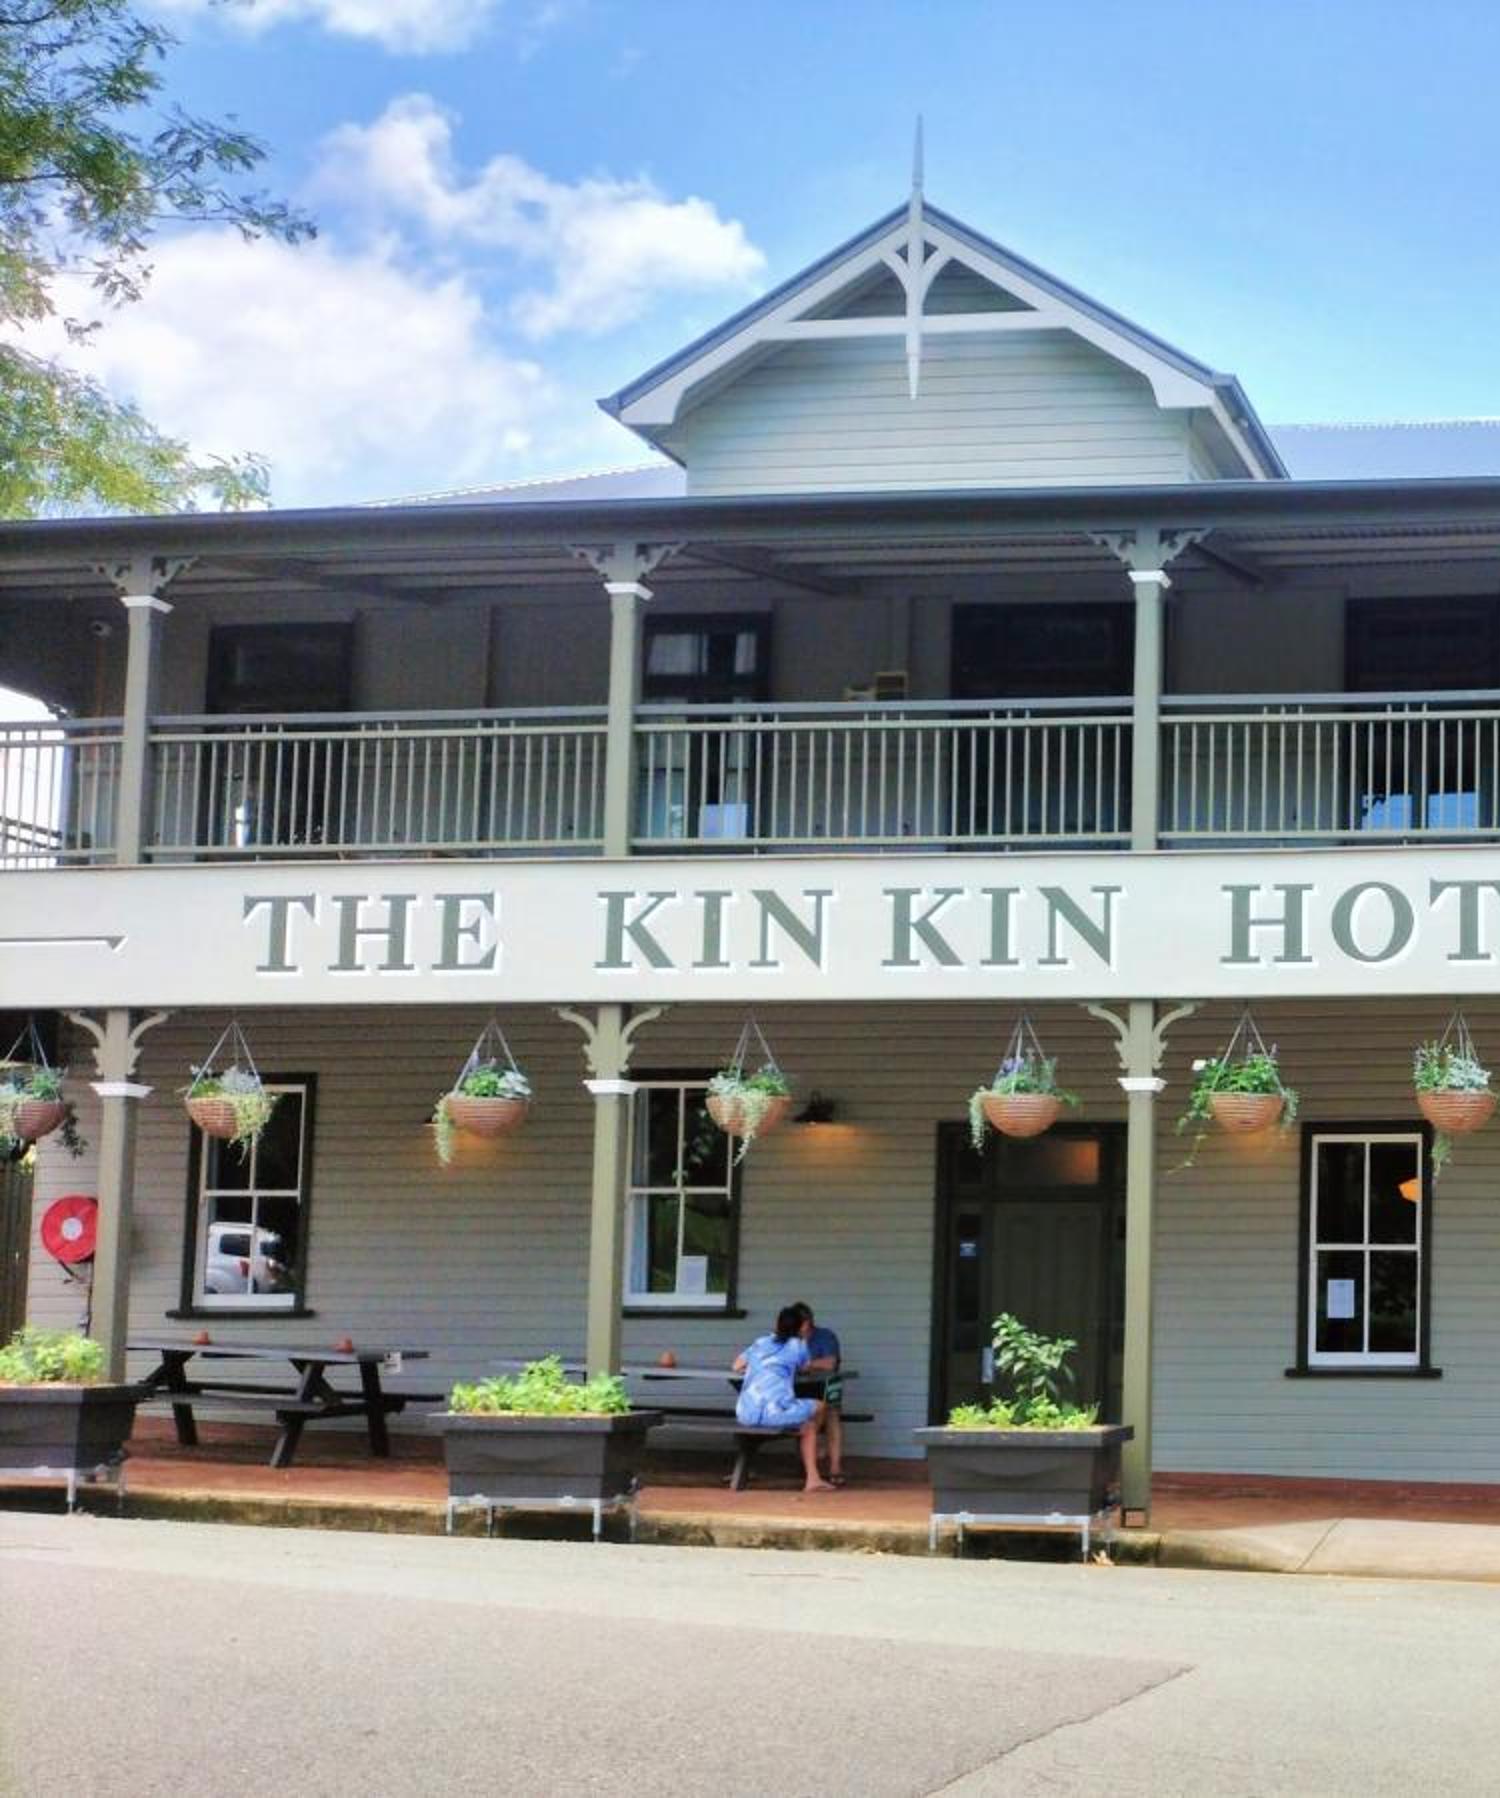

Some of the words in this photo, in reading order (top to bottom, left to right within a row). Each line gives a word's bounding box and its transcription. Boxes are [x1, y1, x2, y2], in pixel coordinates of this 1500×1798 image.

[243, 891, 500, 973] THE
[594, 889, 833, 970] KIN
[881, 885, 1122, 968] KIN
